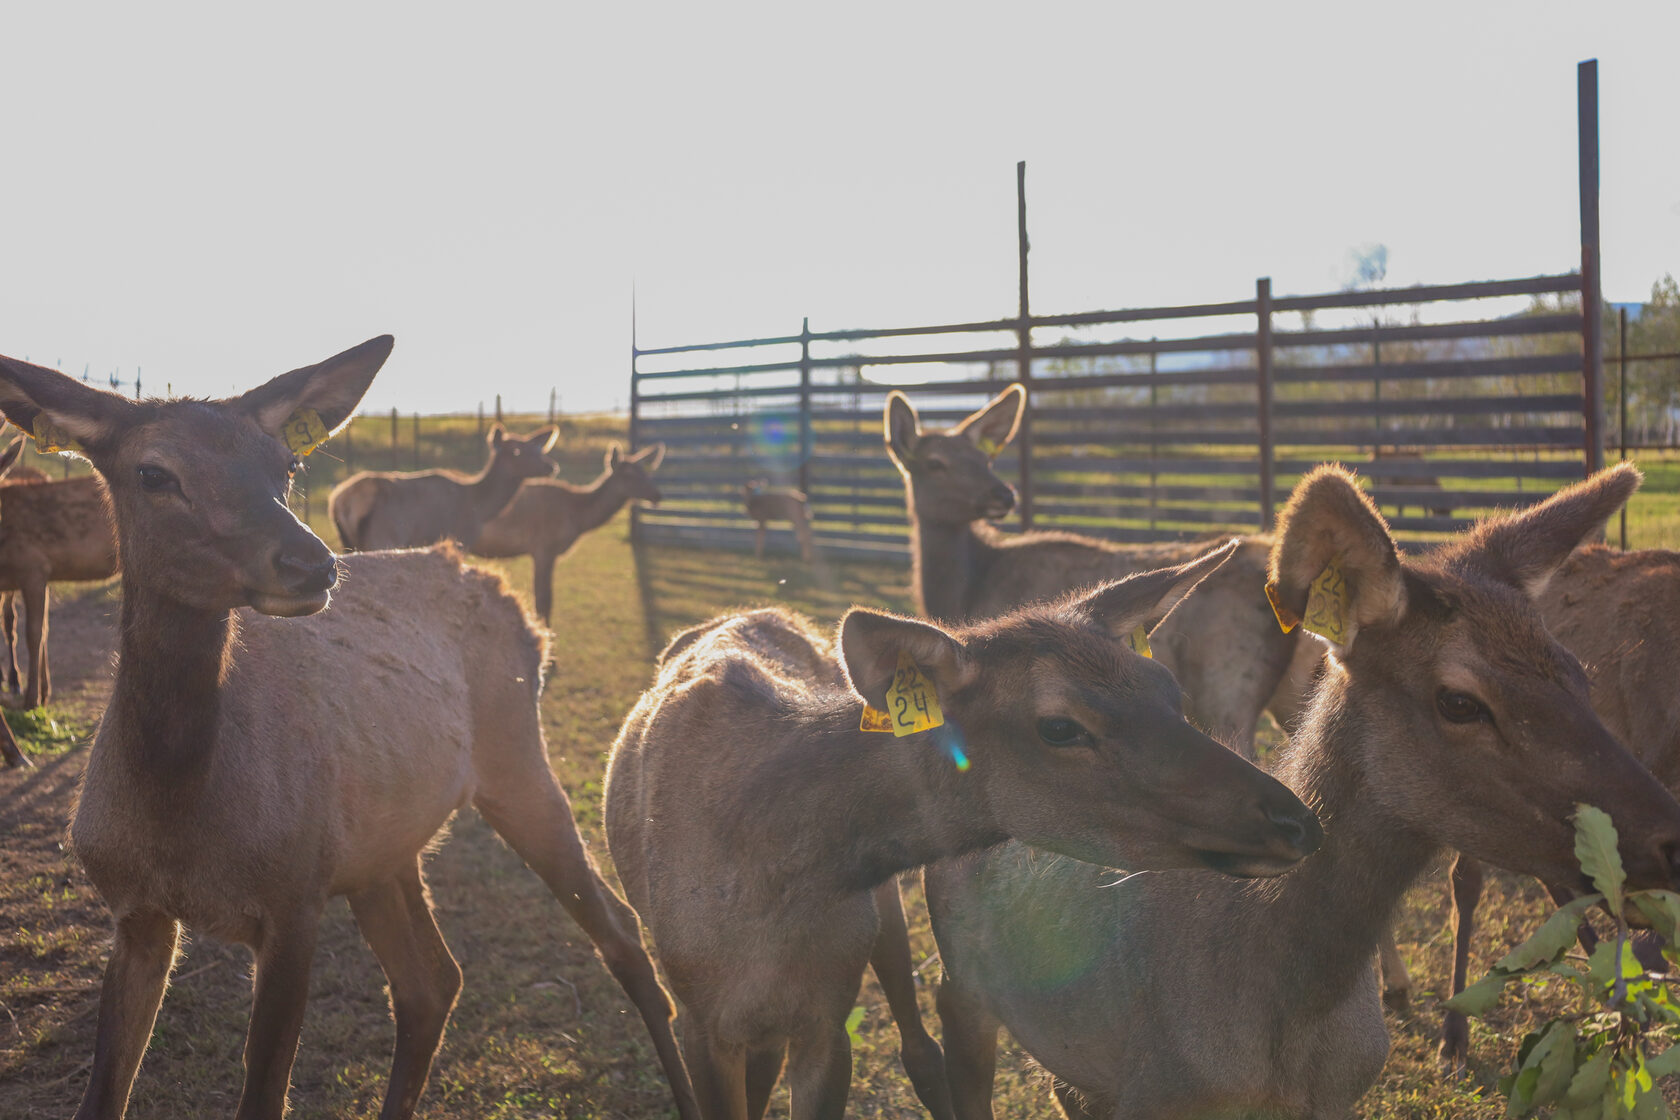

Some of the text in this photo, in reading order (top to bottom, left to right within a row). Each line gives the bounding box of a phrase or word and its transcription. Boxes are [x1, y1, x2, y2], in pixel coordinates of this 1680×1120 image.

[1321, 565, 1343, 597] 22
[896, 666, 925, 694] 22
[895, 691, 932, 727] 24
